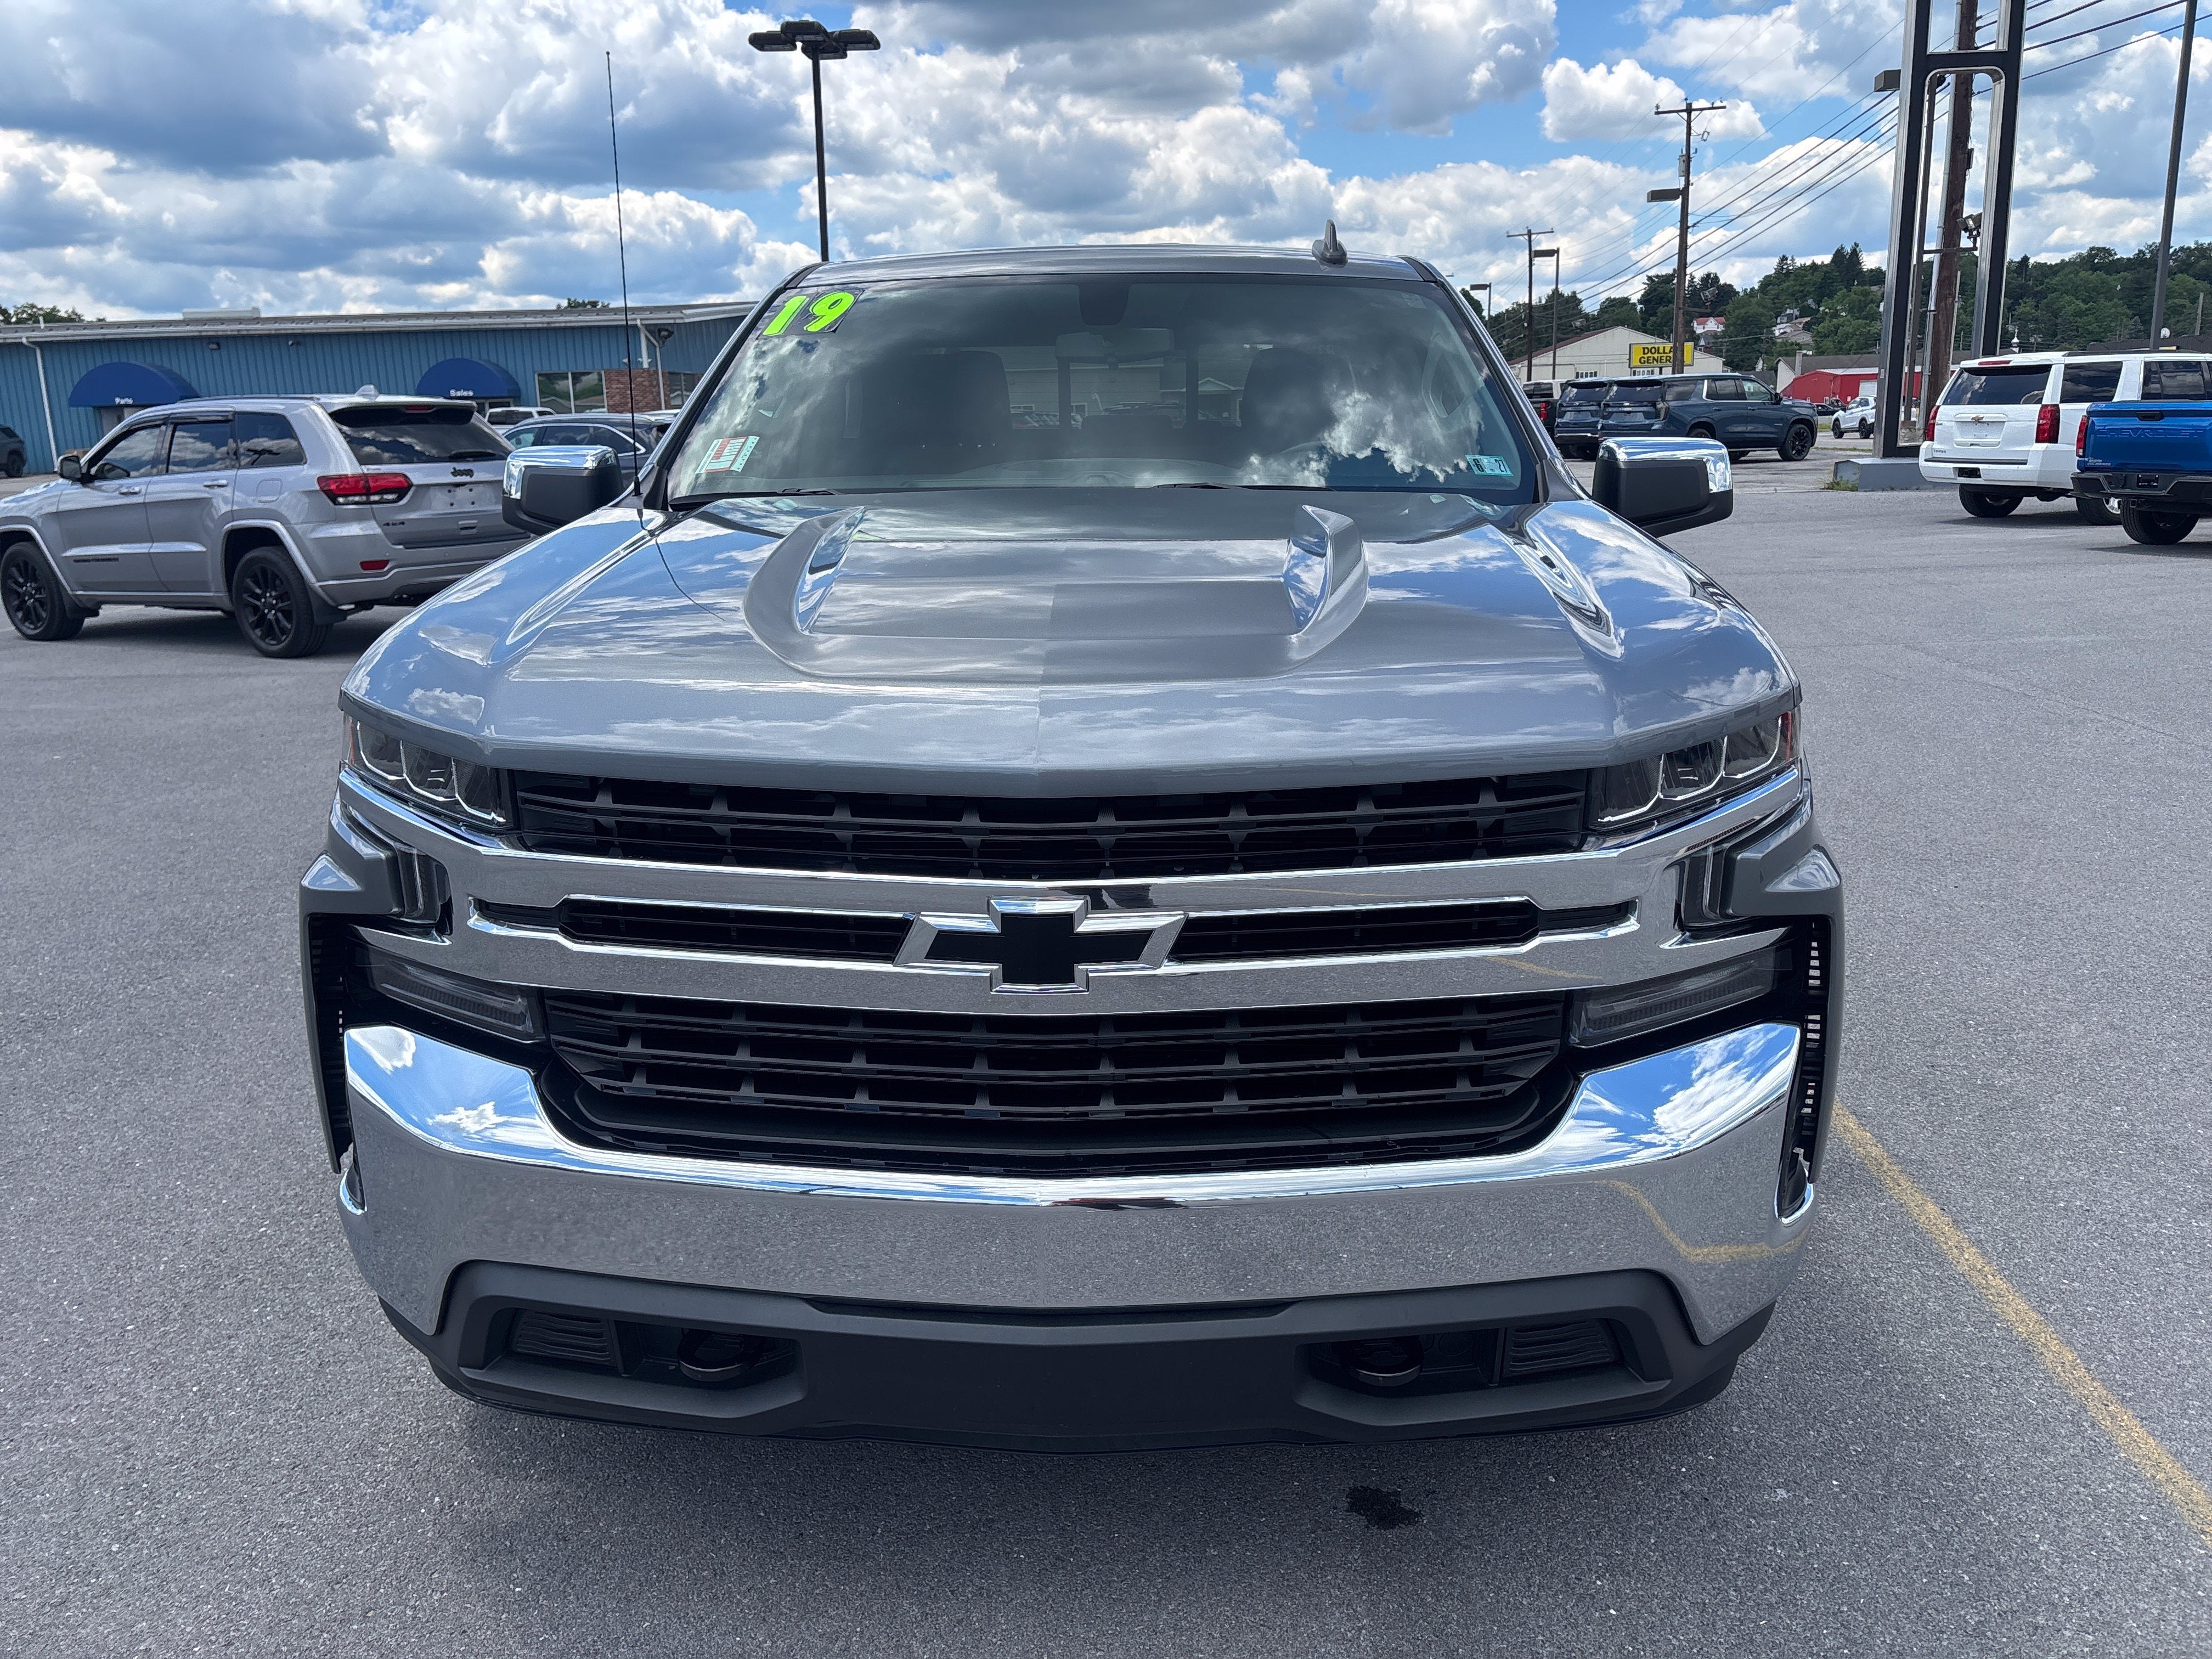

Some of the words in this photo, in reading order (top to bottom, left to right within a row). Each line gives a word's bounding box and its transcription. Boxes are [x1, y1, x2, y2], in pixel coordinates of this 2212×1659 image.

[763, 291, 855, 336] 19
[1639, 356, 1673, 364] GENER
[115, 397, 133, 405] Parts
[1472, 458, 1485, 472] 6
[1494, 459, 1508, 473] 27
[450, 466, 475, 478] Jeep
